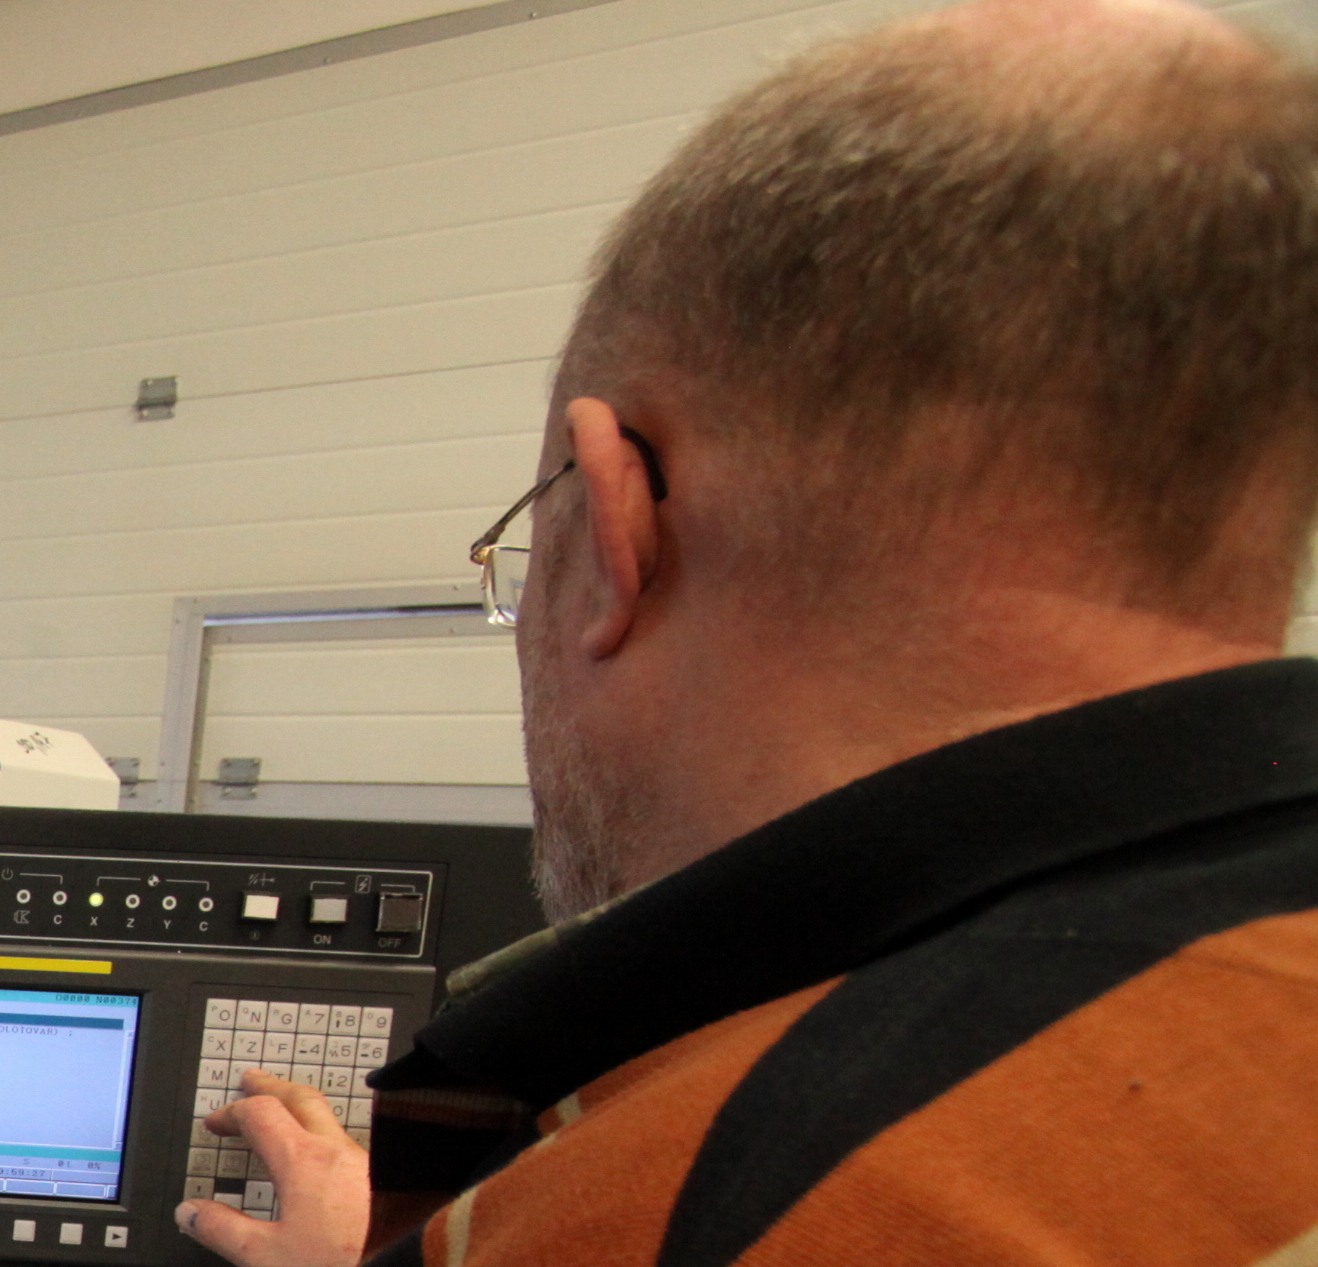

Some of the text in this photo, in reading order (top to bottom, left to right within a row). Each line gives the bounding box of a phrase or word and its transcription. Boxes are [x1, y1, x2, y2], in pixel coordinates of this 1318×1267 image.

[53, 914, 63, 925] C
[90, 916, 99, 926] X
[127, 918, 135, 928] Z
[163, 919, 171, 930] Y
[199, 921, 209, 932] C
[313, 934, 331, 946] ON
[377, 937, 401, 948] OFF
[251, 1012, 261, 1022] N
[281, 1013, 293, 1024] G
[315, 1012, 325, 1024] 7
[345, 1014, 355, 1026] 8
[376, 1016, 387, 1028] 9
[215, 1040, 227, 1052] X
[247, 1042, 257, 1053] Z
[277, 1043, 288, 1054] F
[309, 1044, 319, 1054] 4
[341, 1045, 351, 1057] 5
[372, 1047, 383, 1059] 6
[211, 1070, 223, 1081] M
[307, 1074, 313, 1085] 1
[337, 1076, 348, 1088] 2
